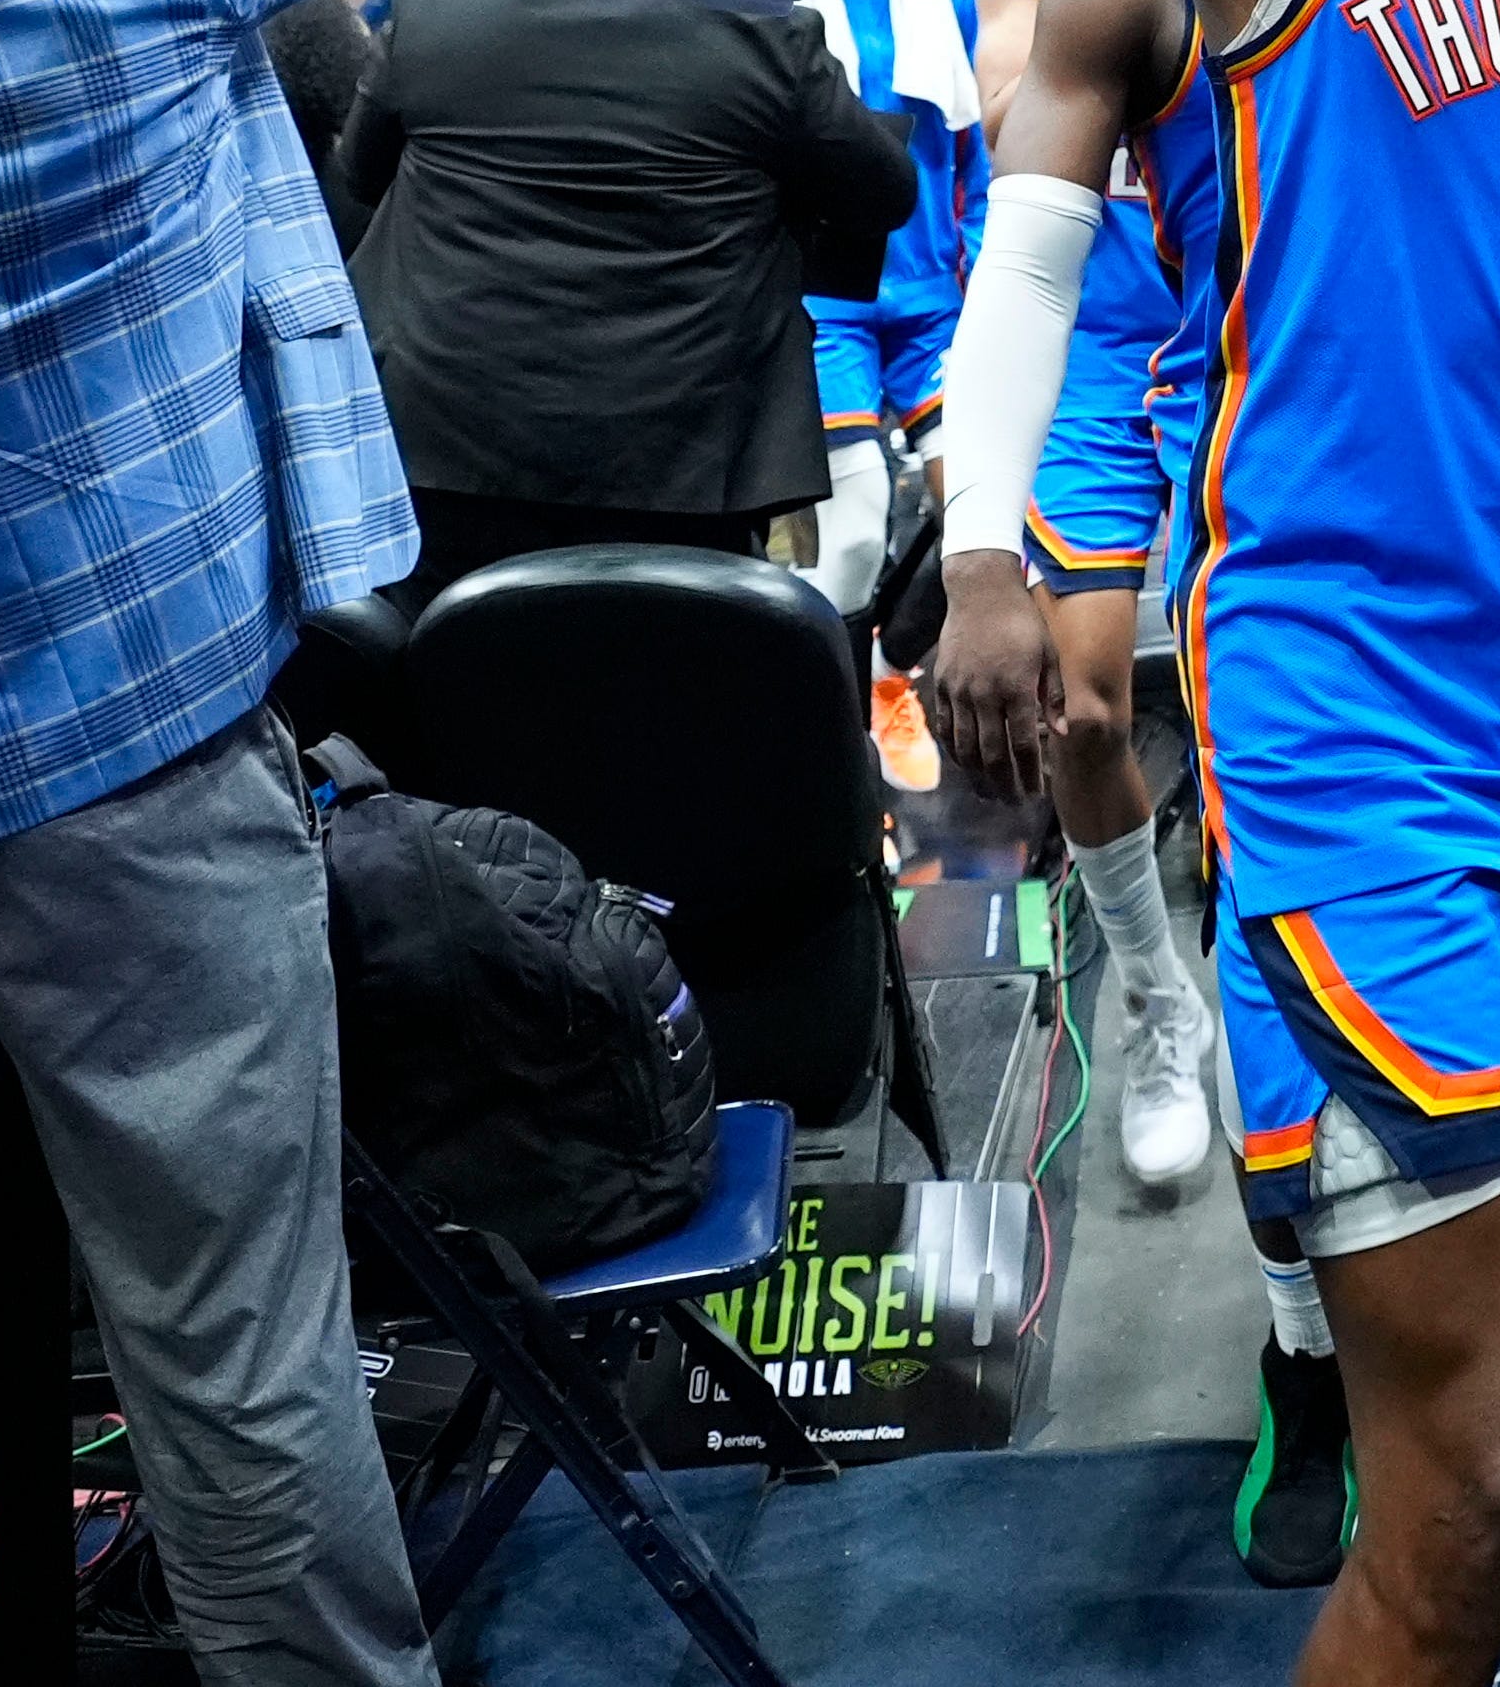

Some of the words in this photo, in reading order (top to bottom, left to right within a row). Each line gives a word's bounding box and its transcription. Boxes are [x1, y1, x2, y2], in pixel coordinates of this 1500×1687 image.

[702, 1252, 941, 1356] NOISE!
[764, 1358, 851, 1398] NOLA
[723, 1433, 767, 1450] enter
[819, 1427, 876, 1443] SMOOTHIE
[874, 1425, 906, 1440] KING
